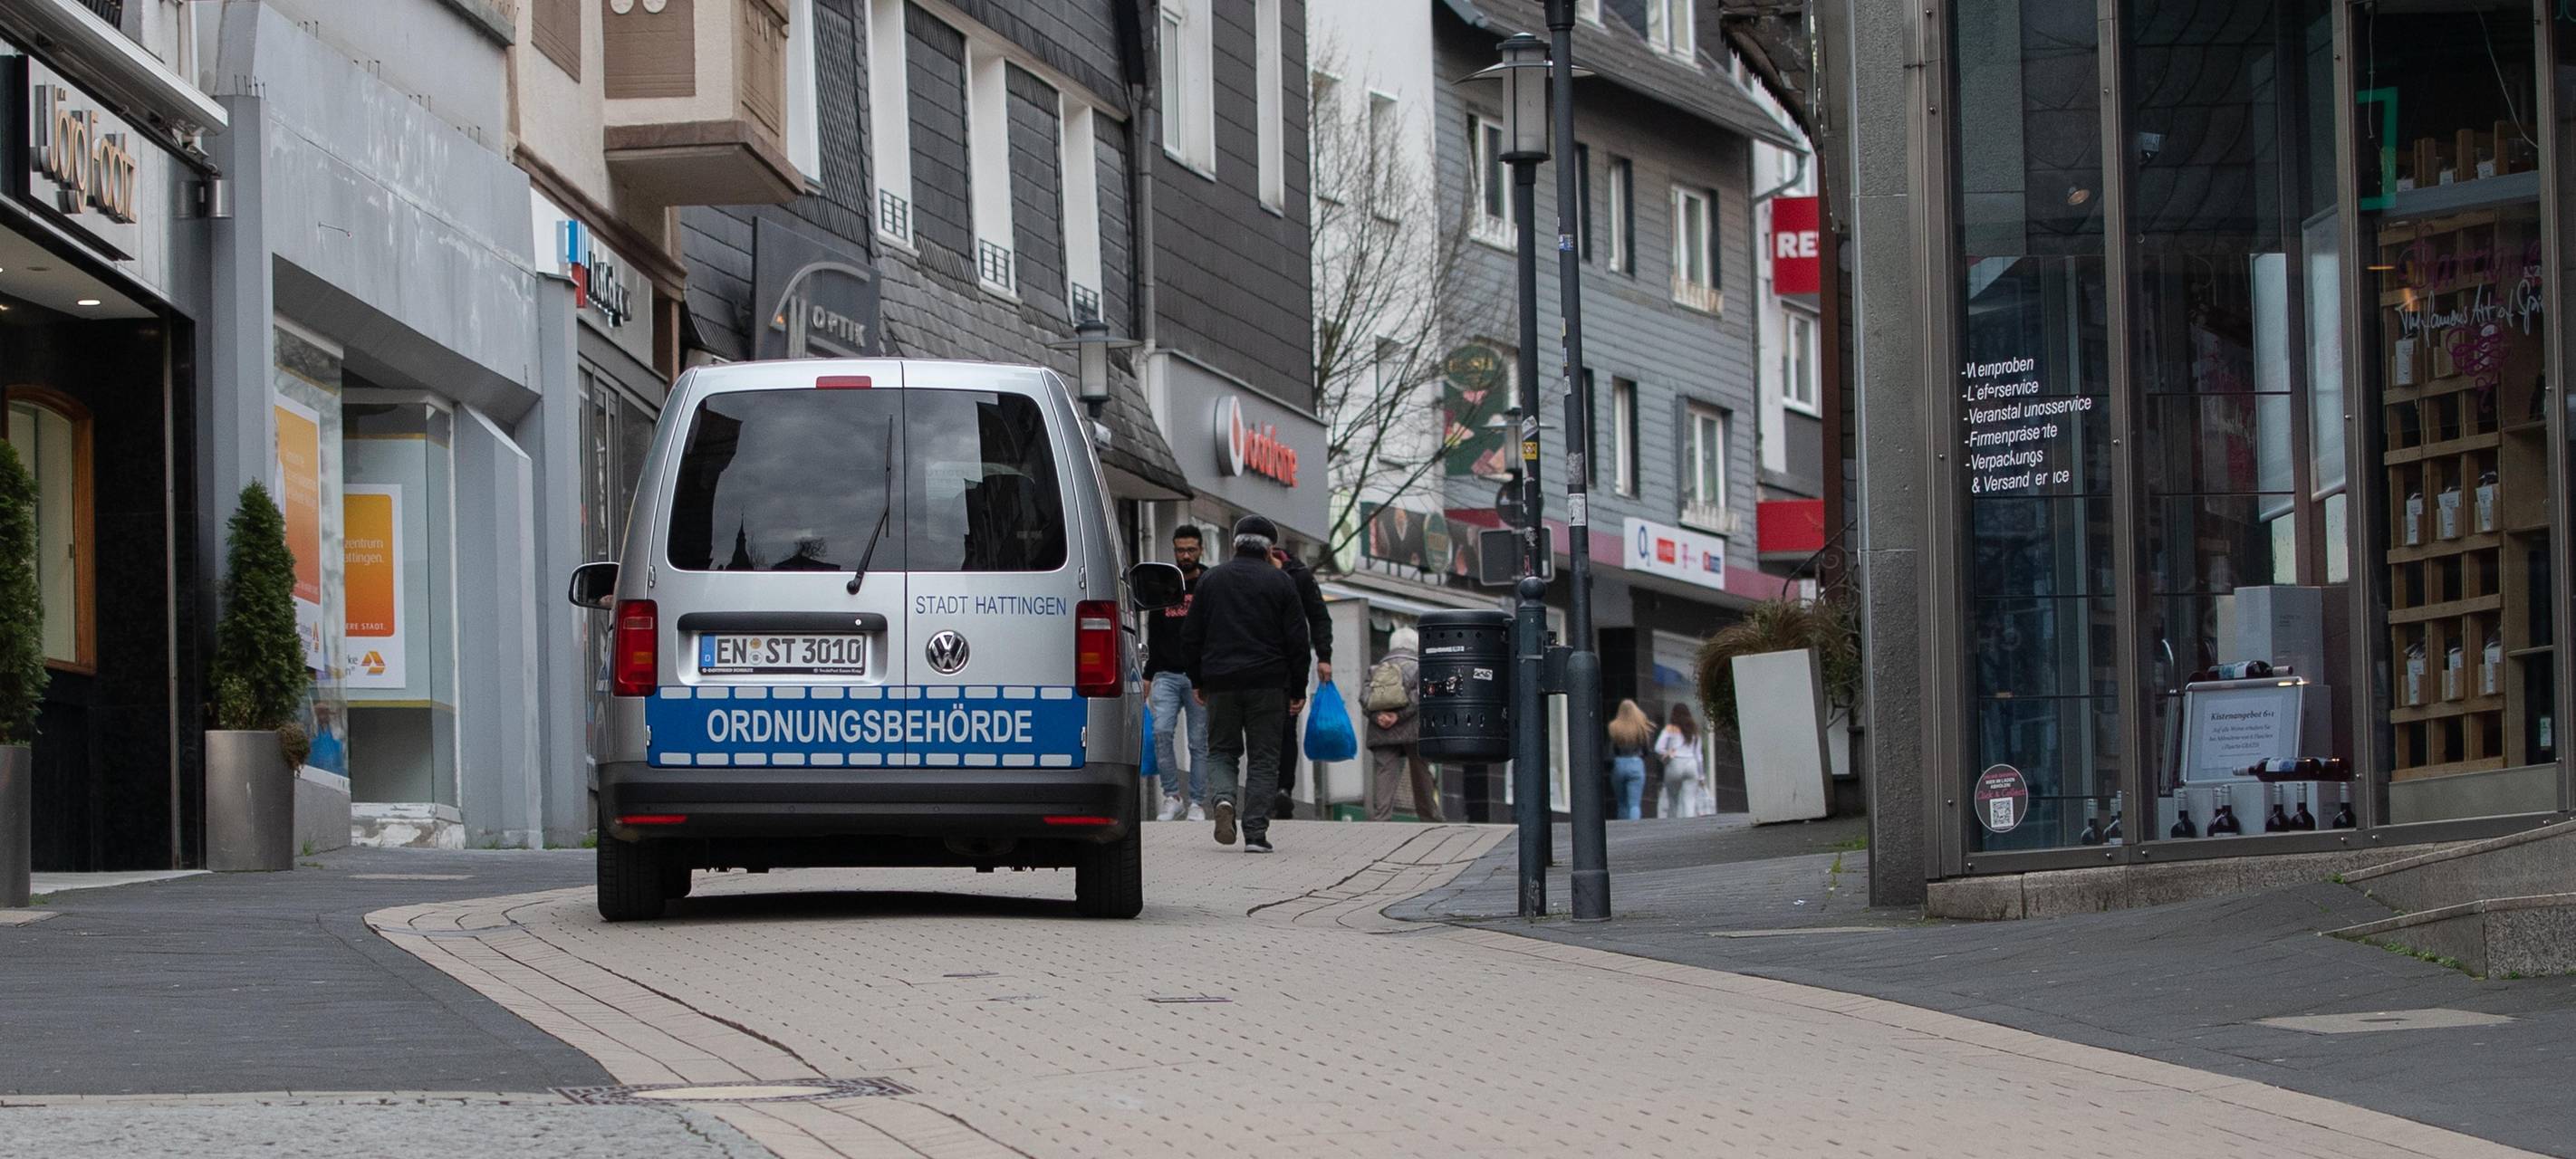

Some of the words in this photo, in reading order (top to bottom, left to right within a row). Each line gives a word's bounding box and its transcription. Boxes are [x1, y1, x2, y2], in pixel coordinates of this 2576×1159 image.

[1777, 230, 1819, 259] RE
[812, 305, 866, 348] OPTIK
[2421, 290, 2467, 348] famous
[2470, 283, 2495, 325] Art
[2497, 289, 2514, 328] of
[1971, 476, 1981, 493] &
[916, 596, 968, 615] STADT
[976, 596, 1067, 616] HATTINGEN
[716, 637, 747, 664] EN
[765, 637, 796, 664] ST
[802, 637, 861, 664] 3010
[706, 703, 1033, 743] ORDNUNGSBEHÖRDE
